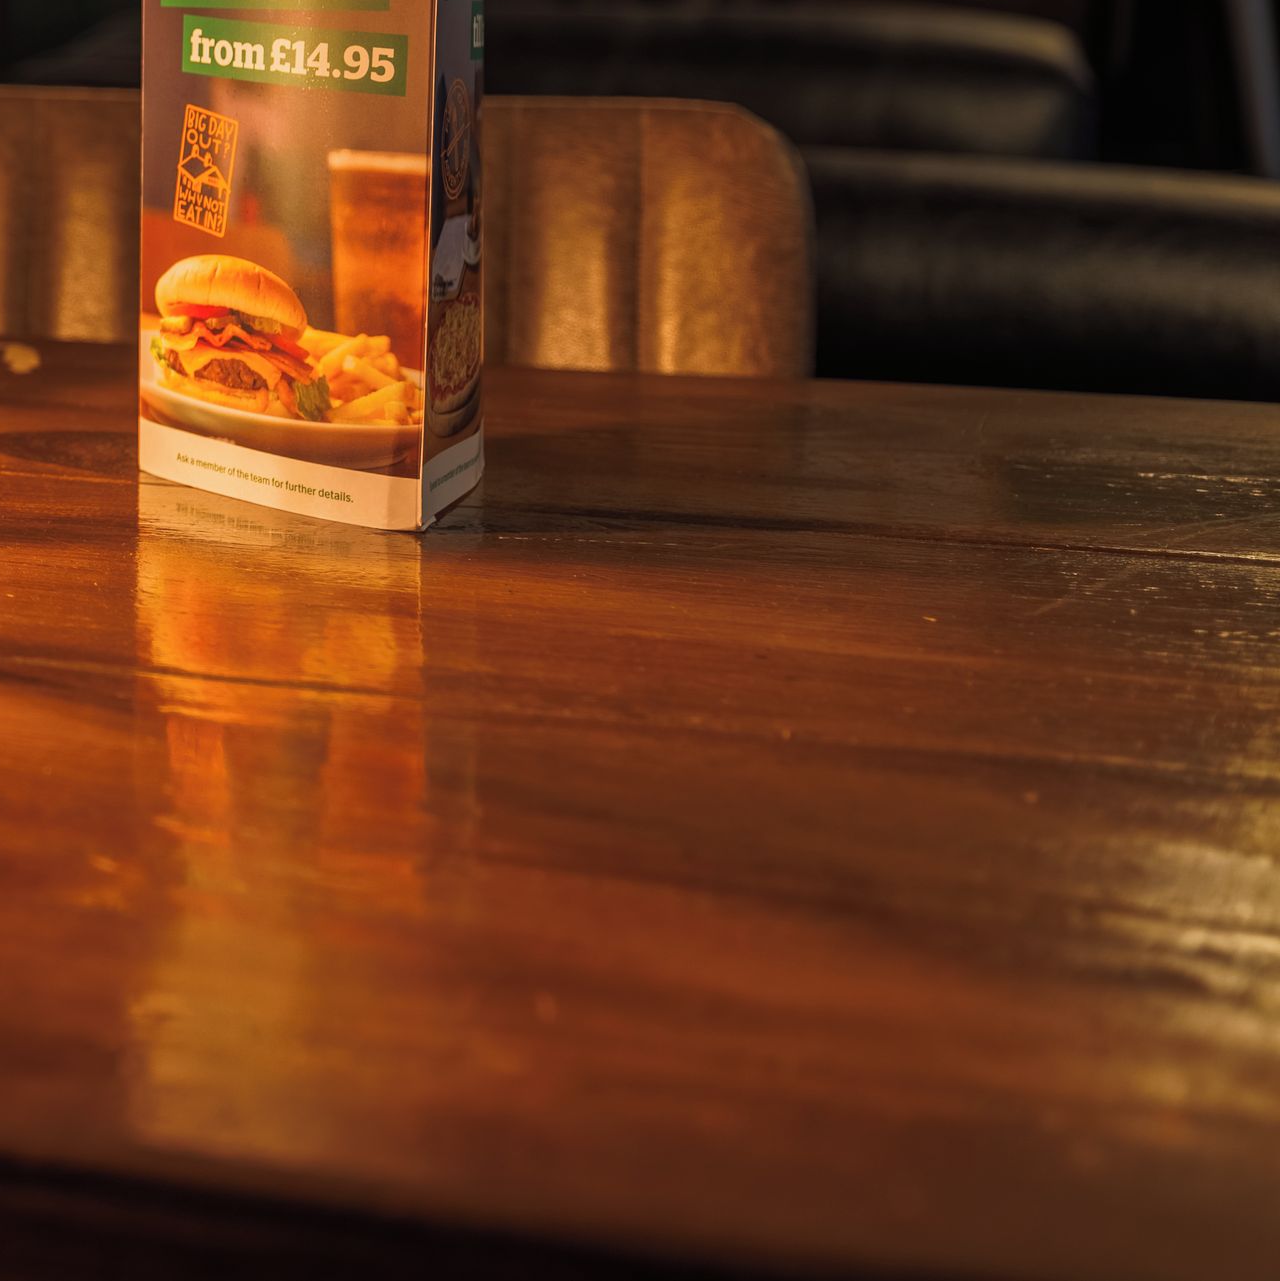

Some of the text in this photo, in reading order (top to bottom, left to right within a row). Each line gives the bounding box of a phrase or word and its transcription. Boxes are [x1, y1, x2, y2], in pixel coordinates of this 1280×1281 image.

[190, 28, 395, 83] from £14.95
[187, 110, 234, 141] BIG DAY
[187, 128, 230, 159] OUT?
[180, 185, 225, 215] WHY NOT
[178, 200, 223, 232] EAT IN?
[176, 453, 189, 465] Ask
[196, 459, 226, 474] member
[227, 467, 235, 476] of
[236, 469, 249, 480] the
[250, 474, 270, 486] team
[271, 477, 284, 490] for
[285, 480, 317, 496] further
[318, 488, 354, 503] details.
